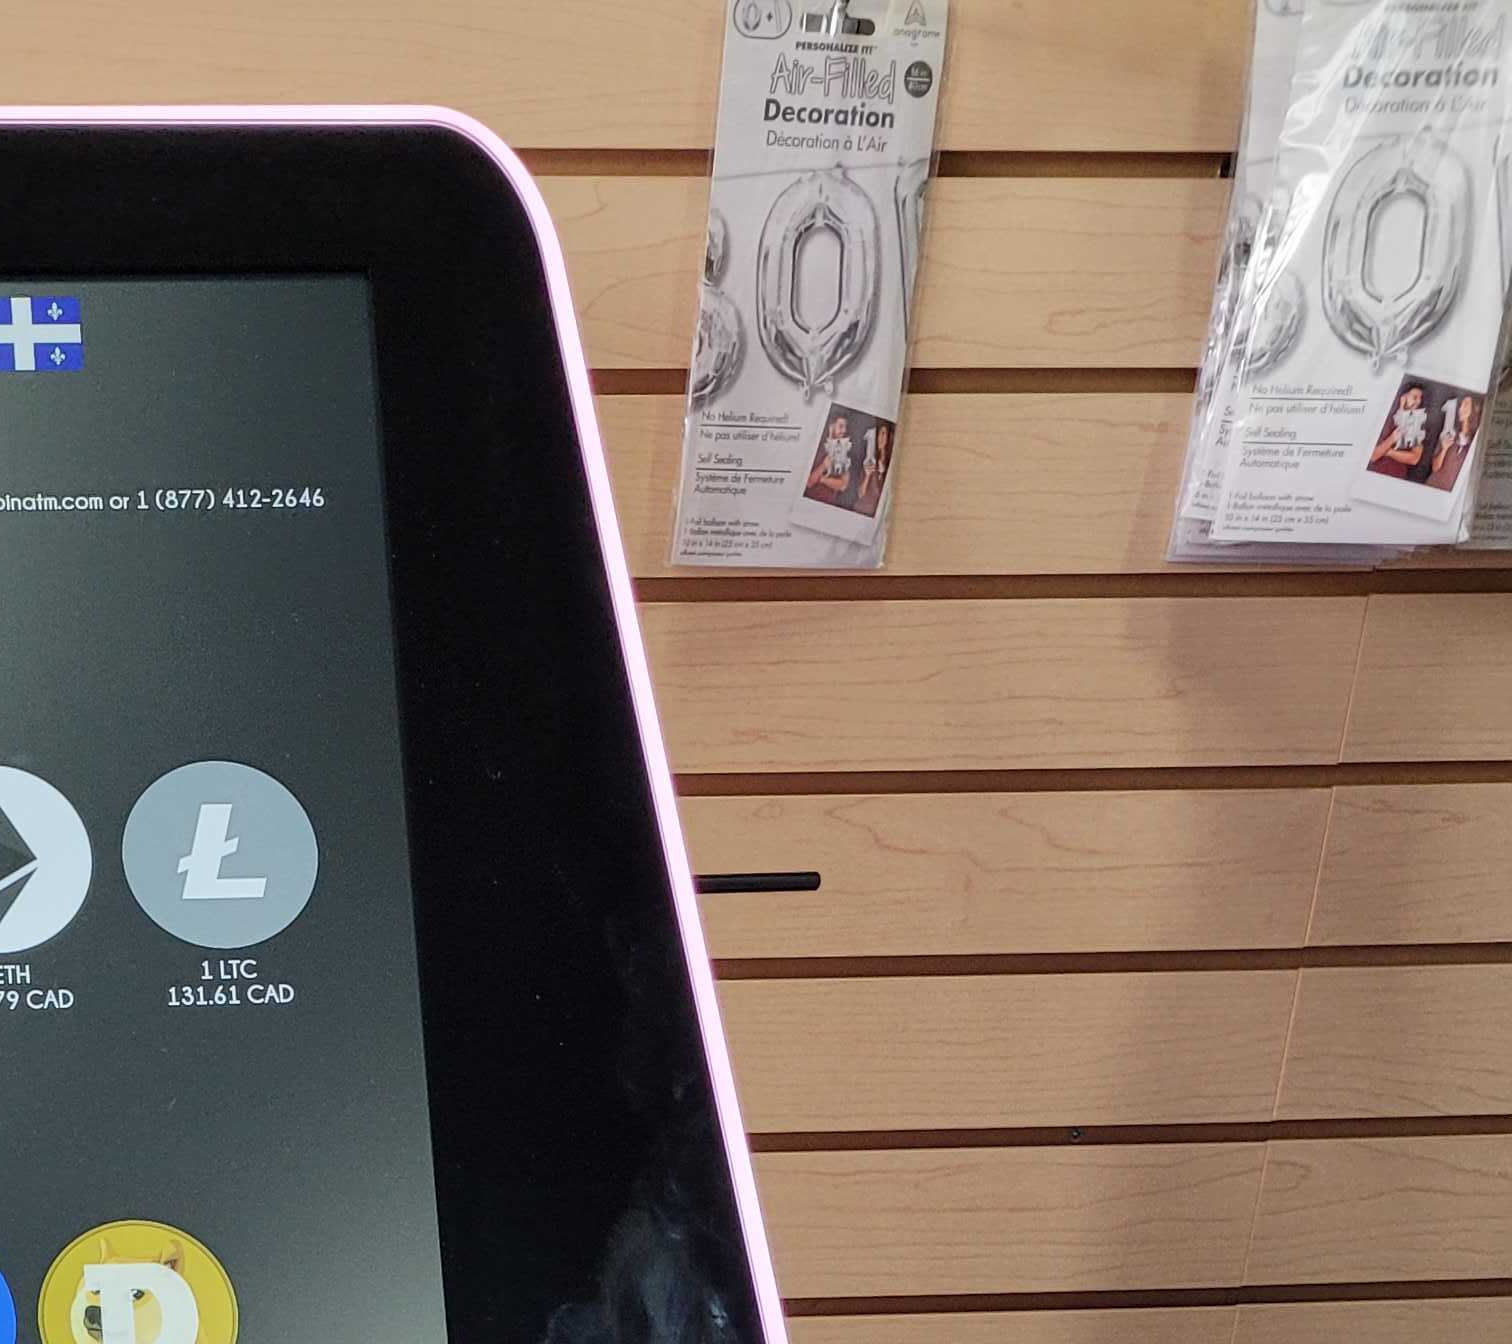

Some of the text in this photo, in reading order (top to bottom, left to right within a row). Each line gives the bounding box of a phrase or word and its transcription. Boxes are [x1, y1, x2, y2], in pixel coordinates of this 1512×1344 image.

[769, 52, 896, 104] Air-Filled
[763, 98, 895, 129] Decoration
[109, 496, 129, 510] or
[137, 491, 148, 510] 1
[154, 489, 215, 512] (877)
[221, 488, 325, 508] 412-2646
[201, 960, 258, 981] 1 LTC
[26, 989, 74, 1010] CAD
[168, 984, 294, 1007] 131.61 CAD
